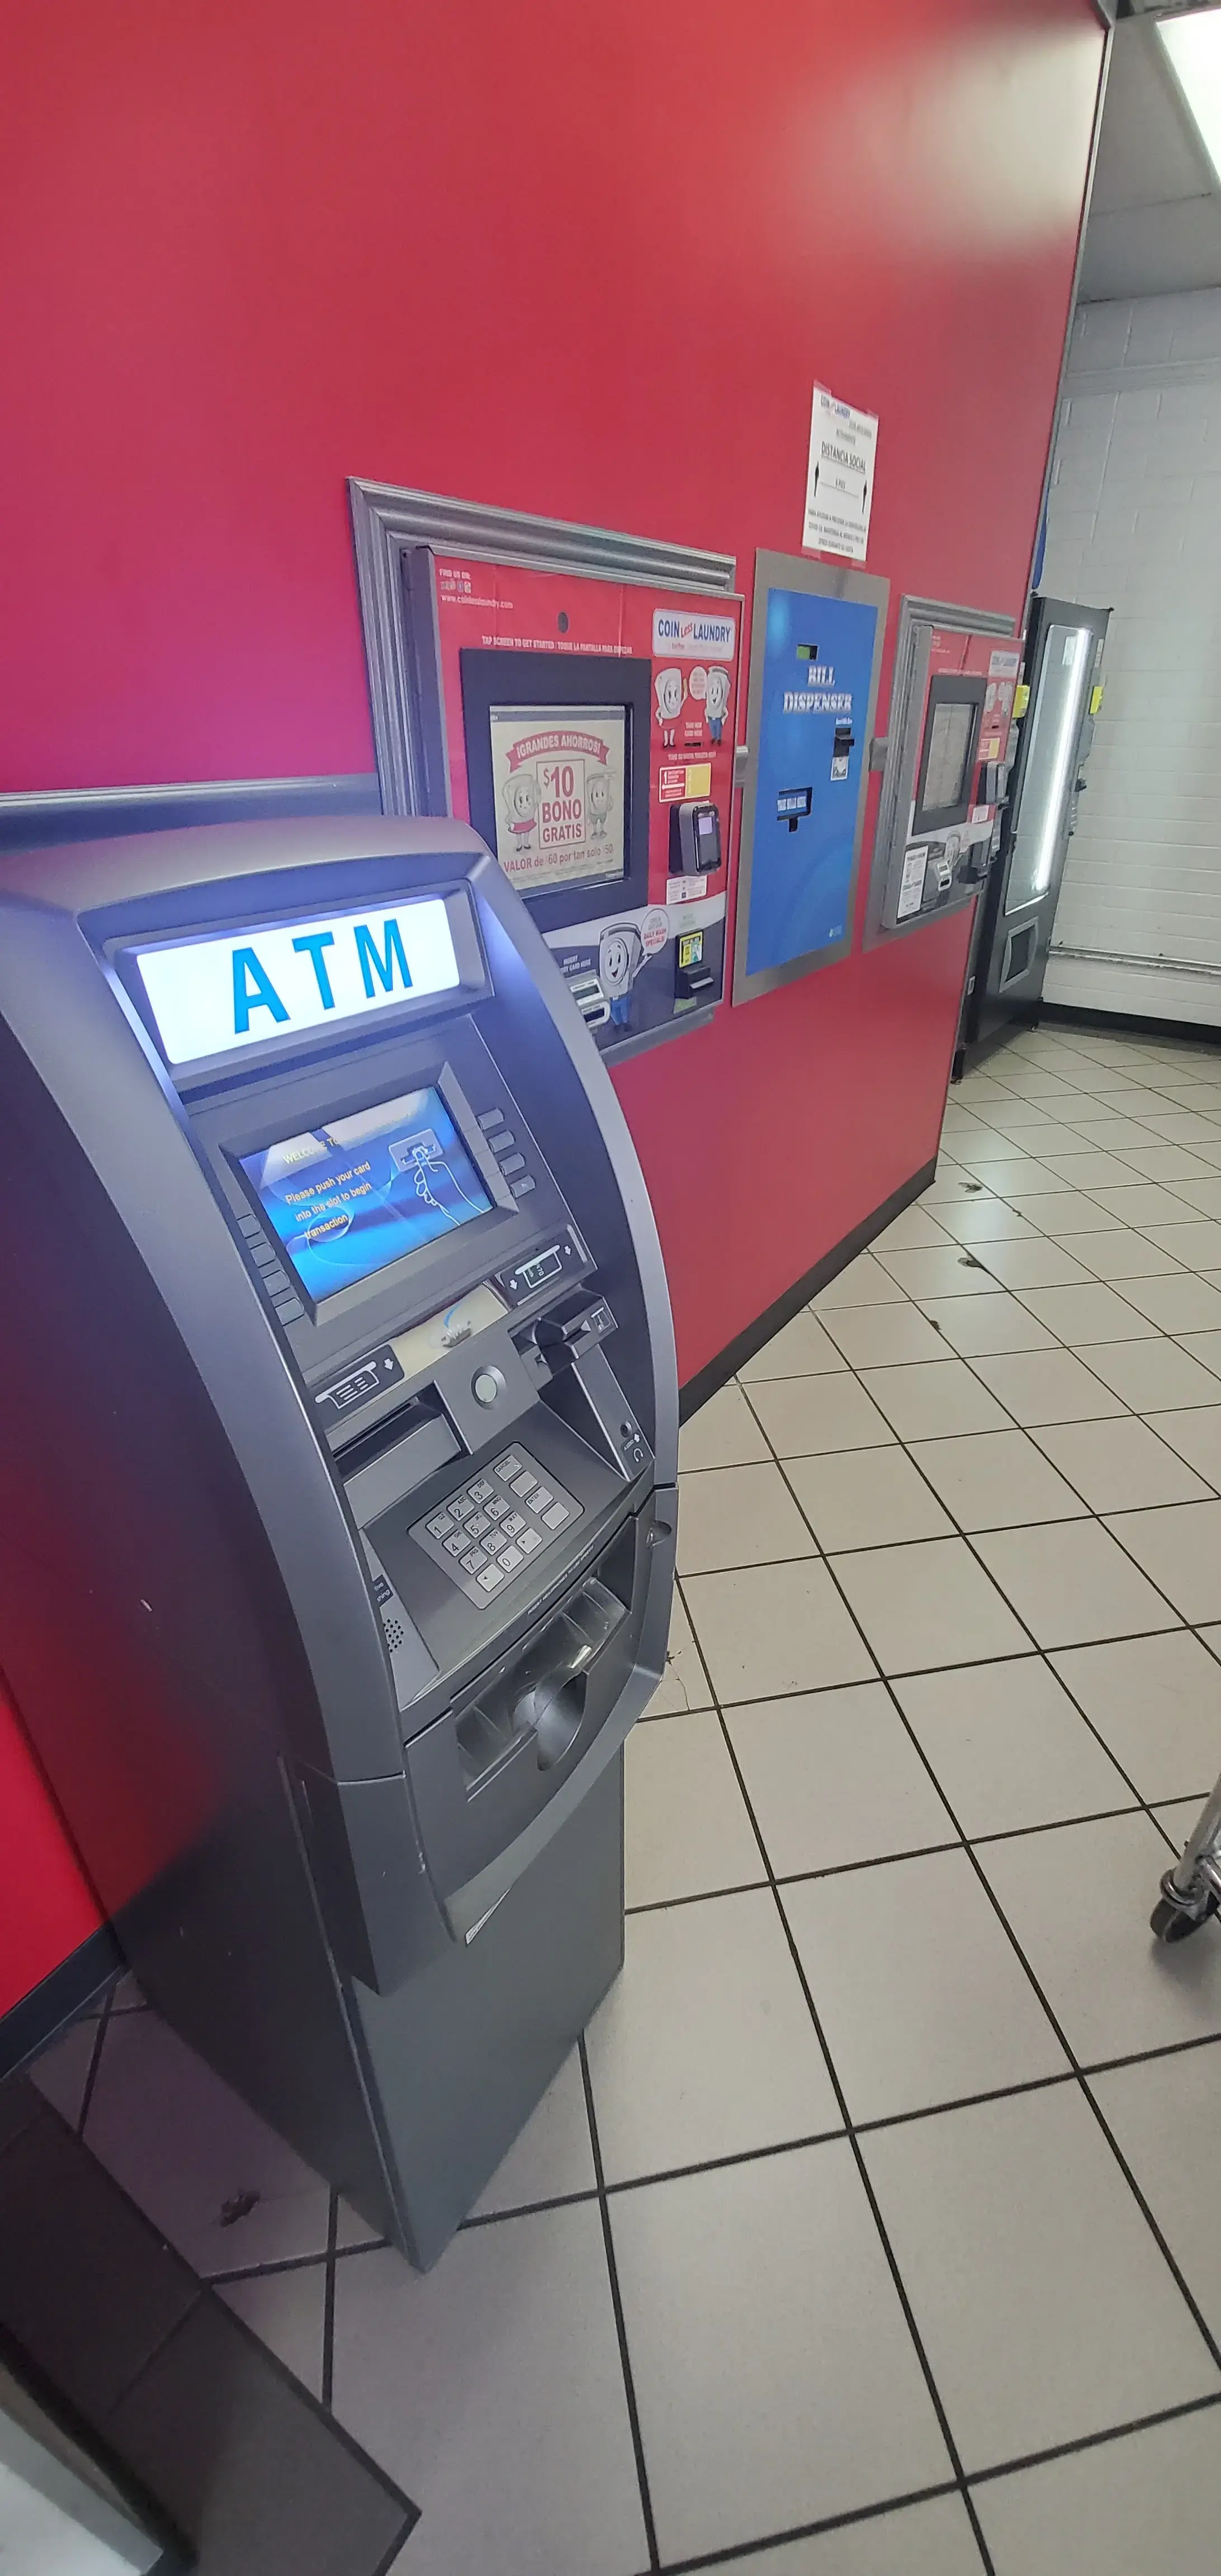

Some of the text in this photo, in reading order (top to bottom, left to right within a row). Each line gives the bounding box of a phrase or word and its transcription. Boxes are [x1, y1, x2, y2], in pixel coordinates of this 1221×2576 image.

[821, 441, 865, 472] DISTANCIA SOCIAL
[659, 619, 679, 638] COIN
[693, 623, 730, 642] LAUNDRY
[807, 665, 835, 686] BILL
[783, 692, 853, 713] DISPENSER
[516, 735, 600, 759] ¡GRANDES AHORROS!
[543, 766, 574, 798] $10
[542, 799, 582, 823] BONO
[542, 823, 581, 843] GRATIS
[503, 858, 532, 872] VALOR
[534, 856, 543, 866] de
[560, 853, 572, 865] por
[573, 850, 585, 861] tan
[587, 847, 601, 858] solo
[231, 918, 413, 1035] ATM
[283, 1140, 326, 1164] WELCOE
[285, 1161, 371, 1205] Please push your card
[295, 1182, 372, 1222] into the slot to begin
[304, 1214, 348, 1239] transaction
[495, 1460, 510, 1472] CANCEL
[457, 1497, 466, 1505] ABC
[474, 1491, 483, 1500] 3
[492, 1497, 501, 1505] MNO
[527, 1493, 539, 1504] ENTER
[454, 1508, 463, 1518] 2
[490, 1508, 499, 1517] 6
[434, 1526, 442, 1535] 1
[470, 1525, 479, 1534] 5
[507, 1524, 515, 1533] 9
[452, 1543, 460, 1552] 4
[487, 1542, 496, 1551] 8
[470, 1549, 479, 1557] PRS
[466, 1560, 475, 1570] 7
[502, 1557, 511, 1566] 0
